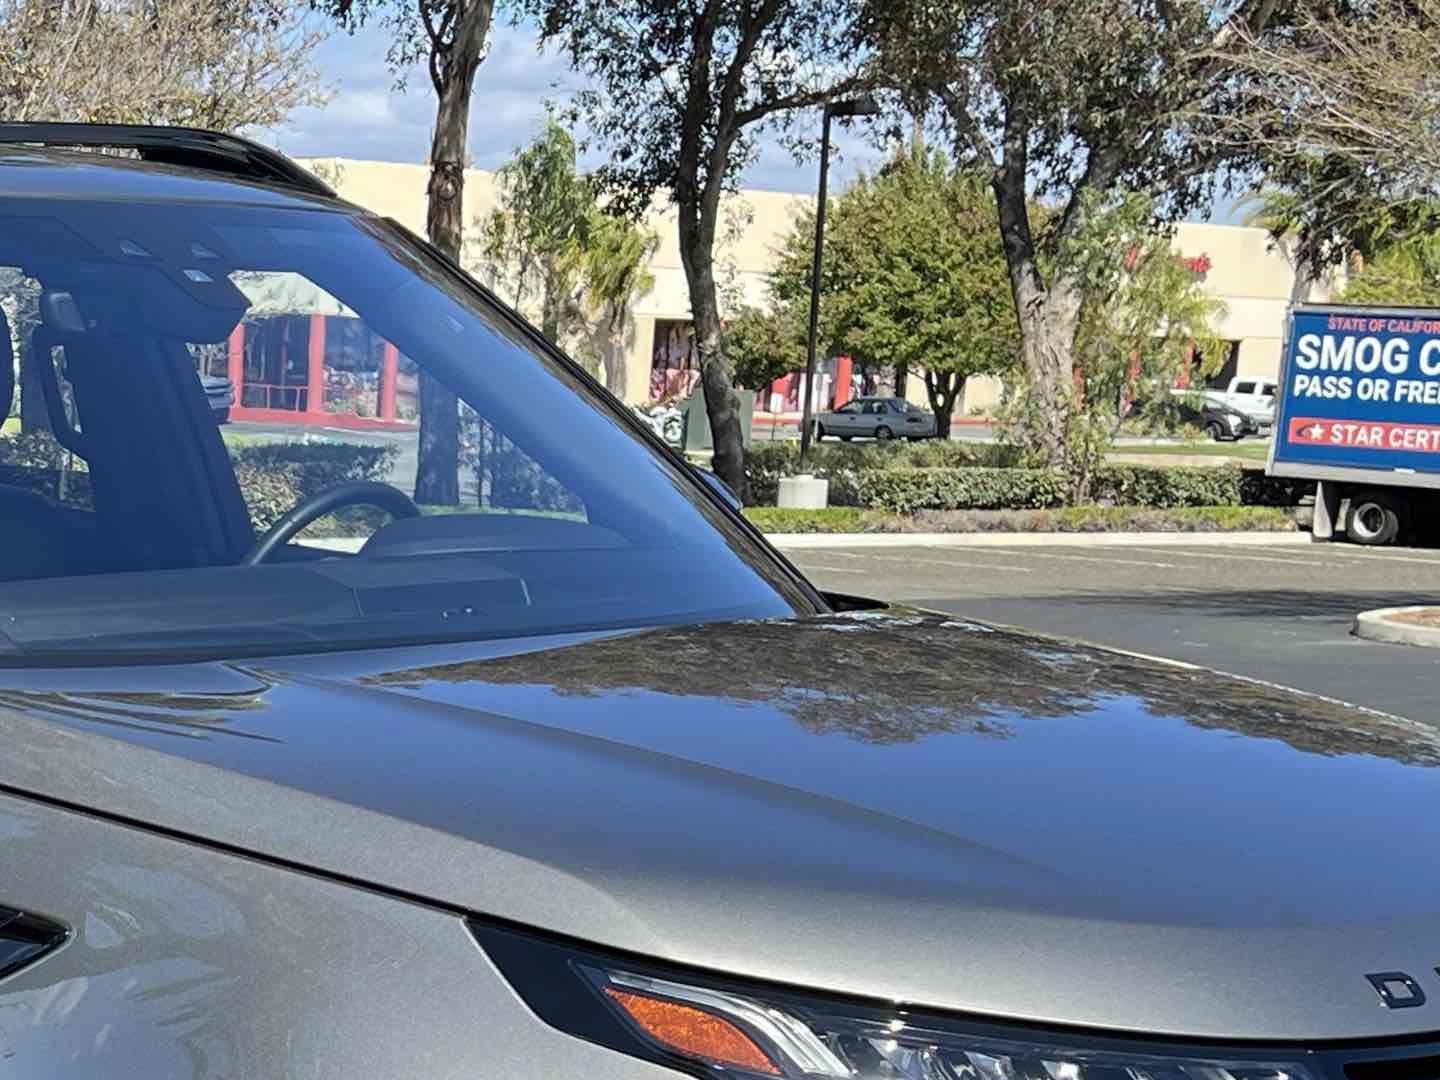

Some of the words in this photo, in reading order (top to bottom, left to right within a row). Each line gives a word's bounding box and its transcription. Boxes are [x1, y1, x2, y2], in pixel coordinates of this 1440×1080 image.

[1327, 317, 1367, 332] STATE
[1369, 318, 1387, 333] OF
[1295, 333, 1411, 375] SMOG
[1293, 374, 1353, 400] PASS
[1356, 378, 1391, 402] OR
[1330, 423, 1384, 447] STAR
[1389, 427, 1440, 451] CERT
[1363, 967, 1440, 1010] D
